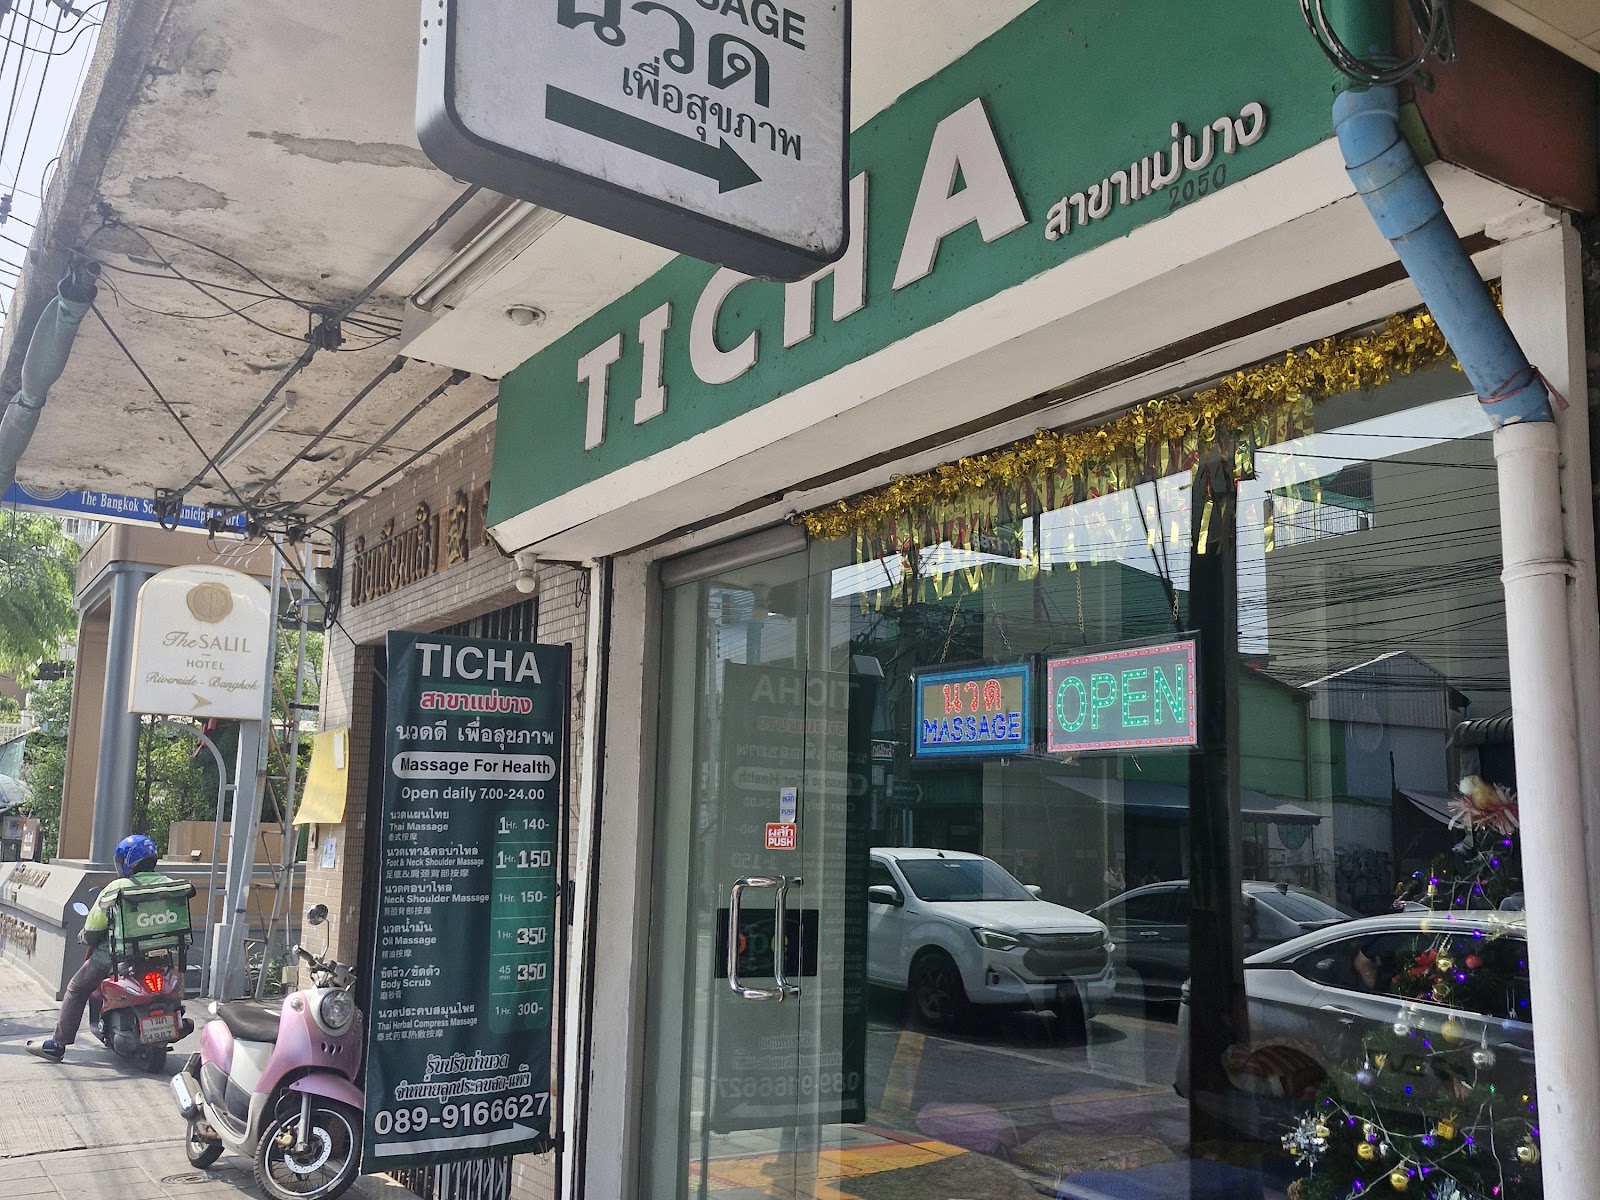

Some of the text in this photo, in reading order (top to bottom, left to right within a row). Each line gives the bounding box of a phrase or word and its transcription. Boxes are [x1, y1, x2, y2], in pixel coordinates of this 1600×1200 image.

[621, 56, 802, 161] เพื่อสุขภาพ
[1044, 101, 1267, 242] สาขาแม่บาง
[1168, 163, 1227, 211] 2050
[577, 97, 1029, 451] TICHA
[81, 490, 97, 507] The
[100, 493, 139, 514] Bangkok
[198, 633, 251, 653] SALIL
[186, 659, 225, 671] HOTEL
[415, 642, 542, 684] TICHA
[145, 671, 197, 686] Riverside
[208, 675, 259, 692] Bangkok
[420, 688, 533, 715] สาขาแม่บาง
[941, 678, 1002, 715] นวด
[1056, 663, 1186, 733] OPEN
[395, 715, 554, 750] นวดดี เพื่อสุขภาพ
[922, 711, 1022, 744] MASSAGE
[400, 757, 550, 775] Massage For Health
[401, 786, 439, 801] Open
[443, 787, 476, 802] daily
[389, 822, 449, 833] Thai Massage
[768, 825, 794, 837] ผลัก
[767, 837, 794, 847] PUSH
[386, 858, 400, 867] Foot
[406, 858, 425, 867] Neck
[426, 857, 456, 867] Shoulder
[457, 857, 485, 867] Massage
[383, 893, 490, 905] Neck Shoulder Massage
[136, 909, 179, 928] Grab
[382, 936, 437, 947] Oil Massage
[498, 965, 511, 974] 45
[380, 979, 432, 991] Body Scrub
[377, 1016, 478, 1031] Thai Herbal Compress Massage
[374, 1091, 550, 1136] 089-9166627
